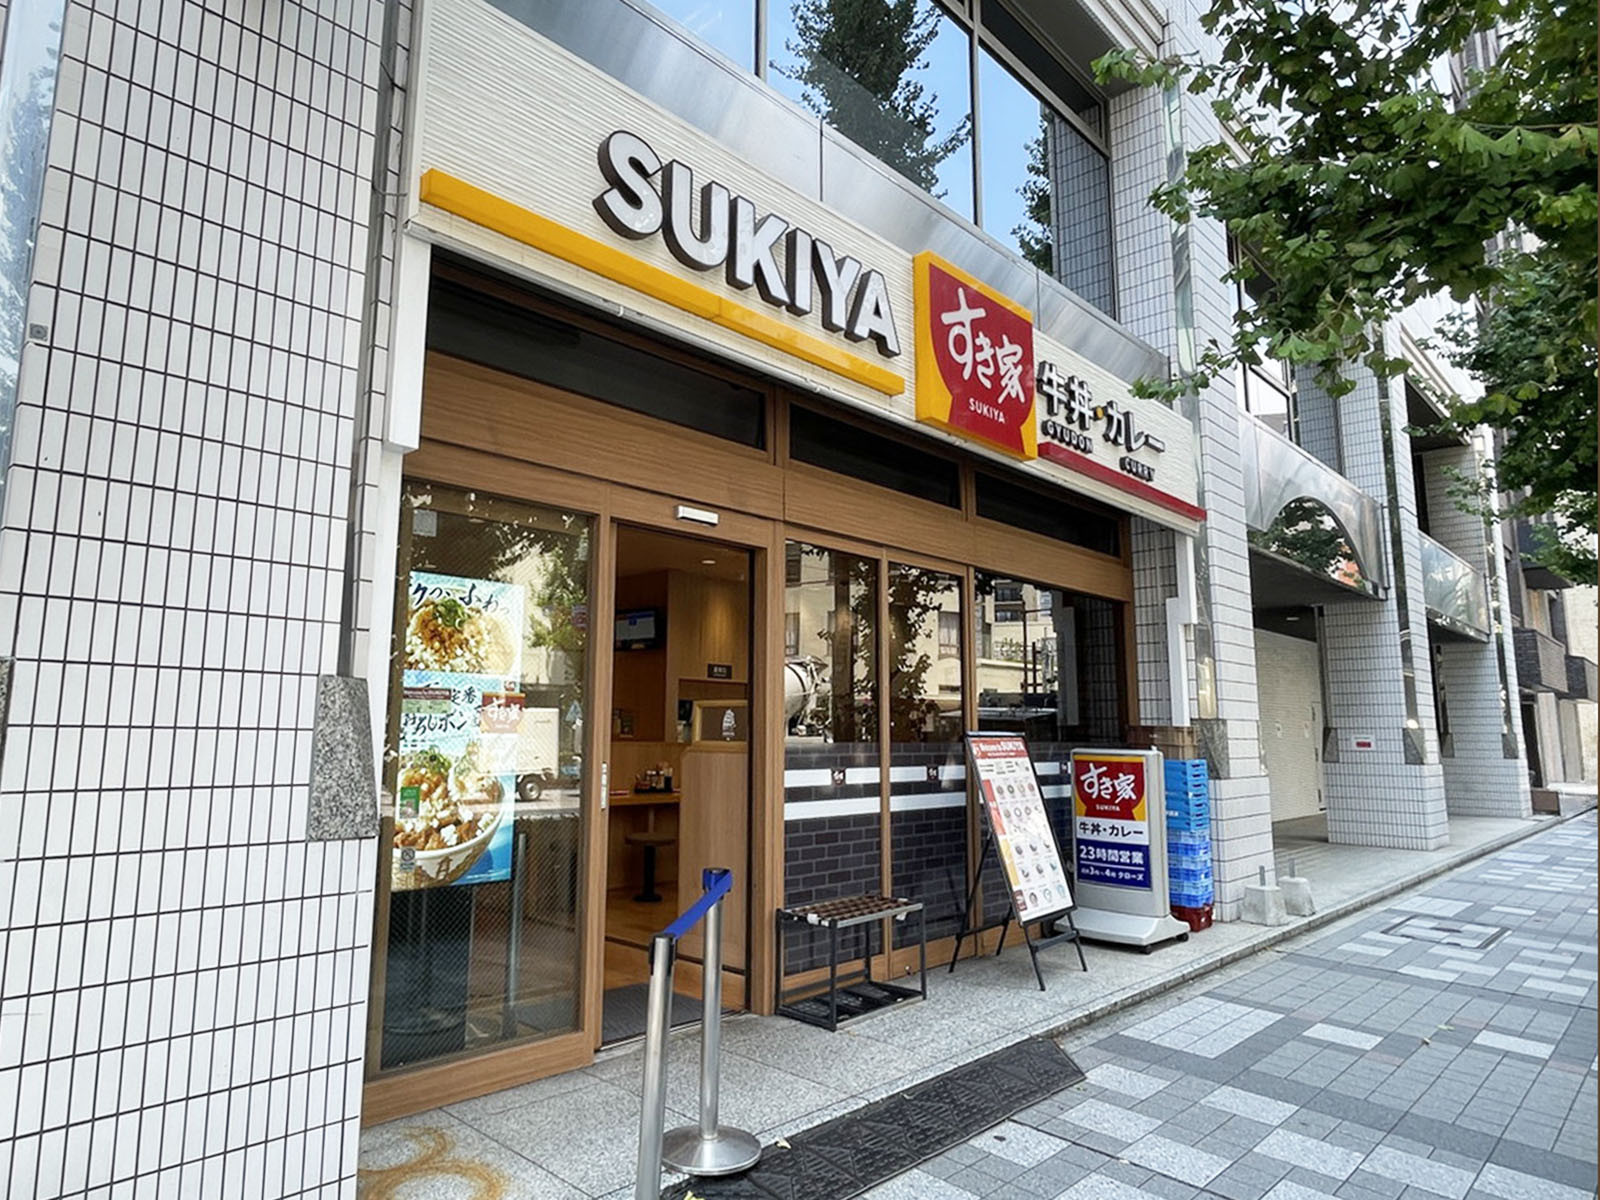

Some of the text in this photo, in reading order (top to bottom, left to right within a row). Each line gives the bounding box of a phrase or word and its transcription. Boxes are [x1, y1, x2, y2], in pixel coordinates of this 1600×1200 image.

[593, 130, 901, 359] SUKIYA
[941, 287, 1025, 404] すき家
[968, 397, 1006, 424] SUKIYA
[1041, 419, 1093, 454] GYUDON
[1119, 456, 1156, 482] CURRY
[1080, 762, 1137, 804] すき家
[1095, 804, 1121, 812] SUKIYA
[1079, 820, 1144, 839] 牛丼・カレー
[1080, 845, 1144, 865] 23時間営業
